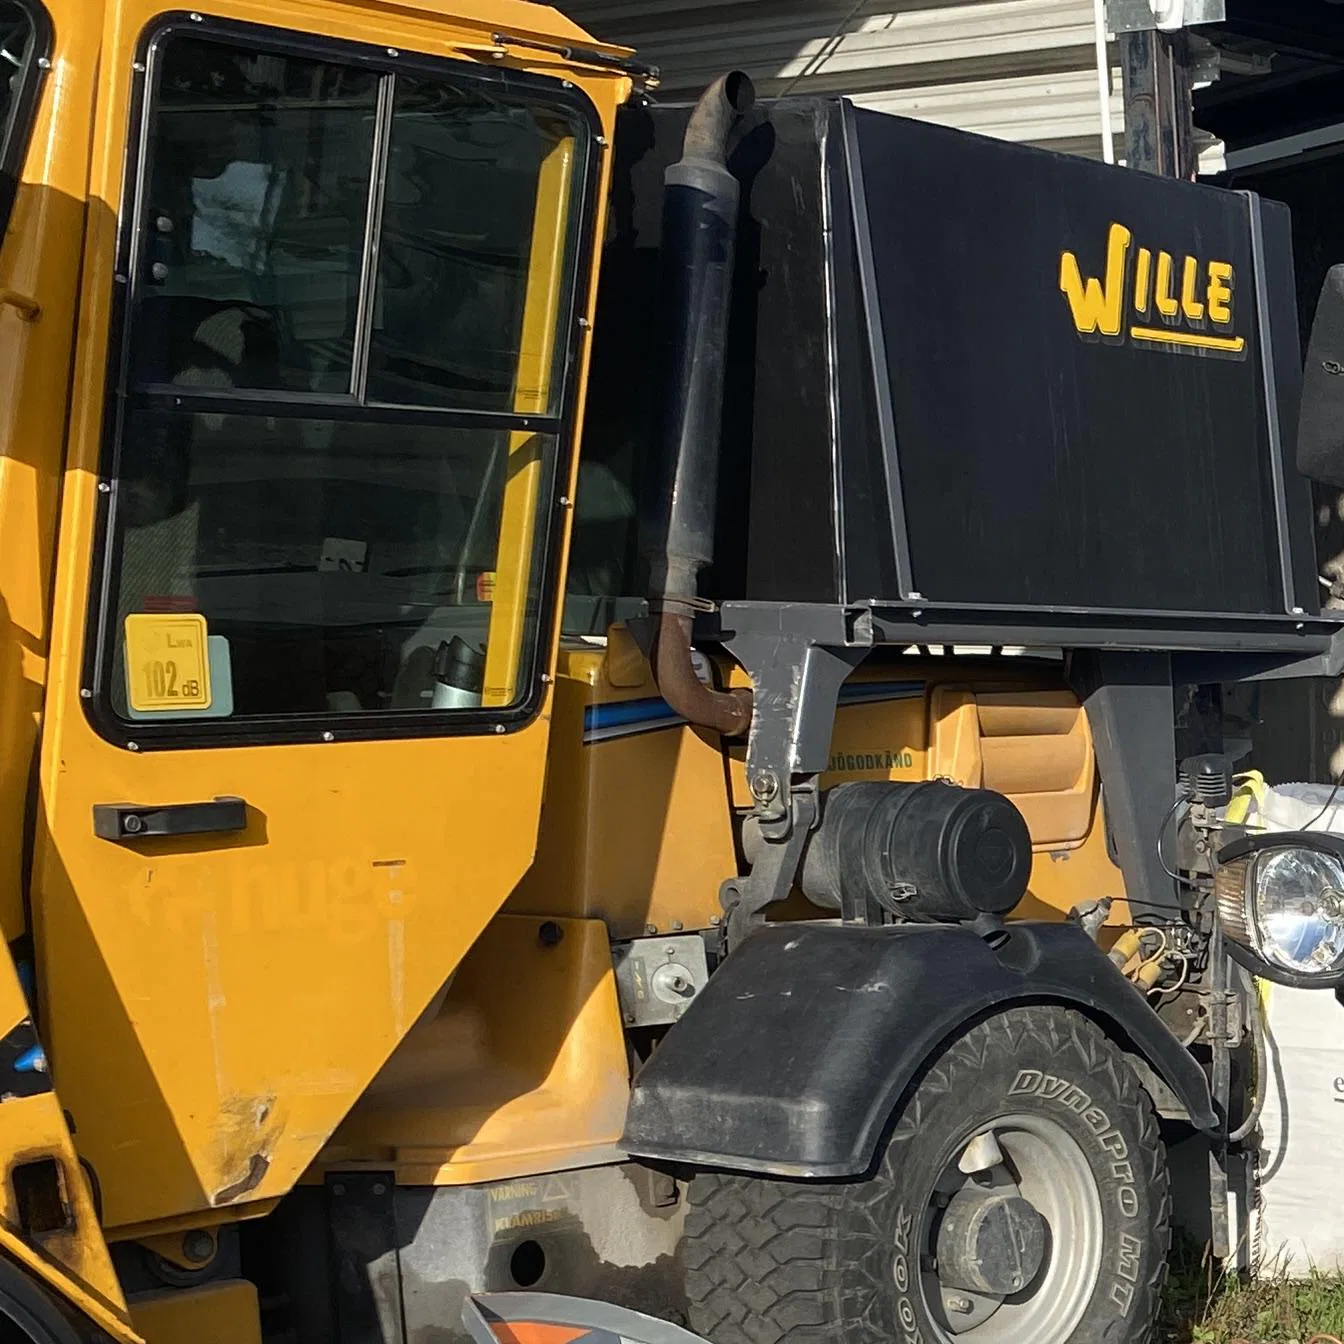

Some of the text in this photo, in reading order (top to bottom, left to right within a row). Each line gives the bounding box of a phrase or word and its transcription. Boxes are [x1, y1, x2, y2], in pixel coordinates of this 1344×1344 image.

[1060, 223, 1233, 336] WILLE
[143, 661, 200, 697] 102 dB
